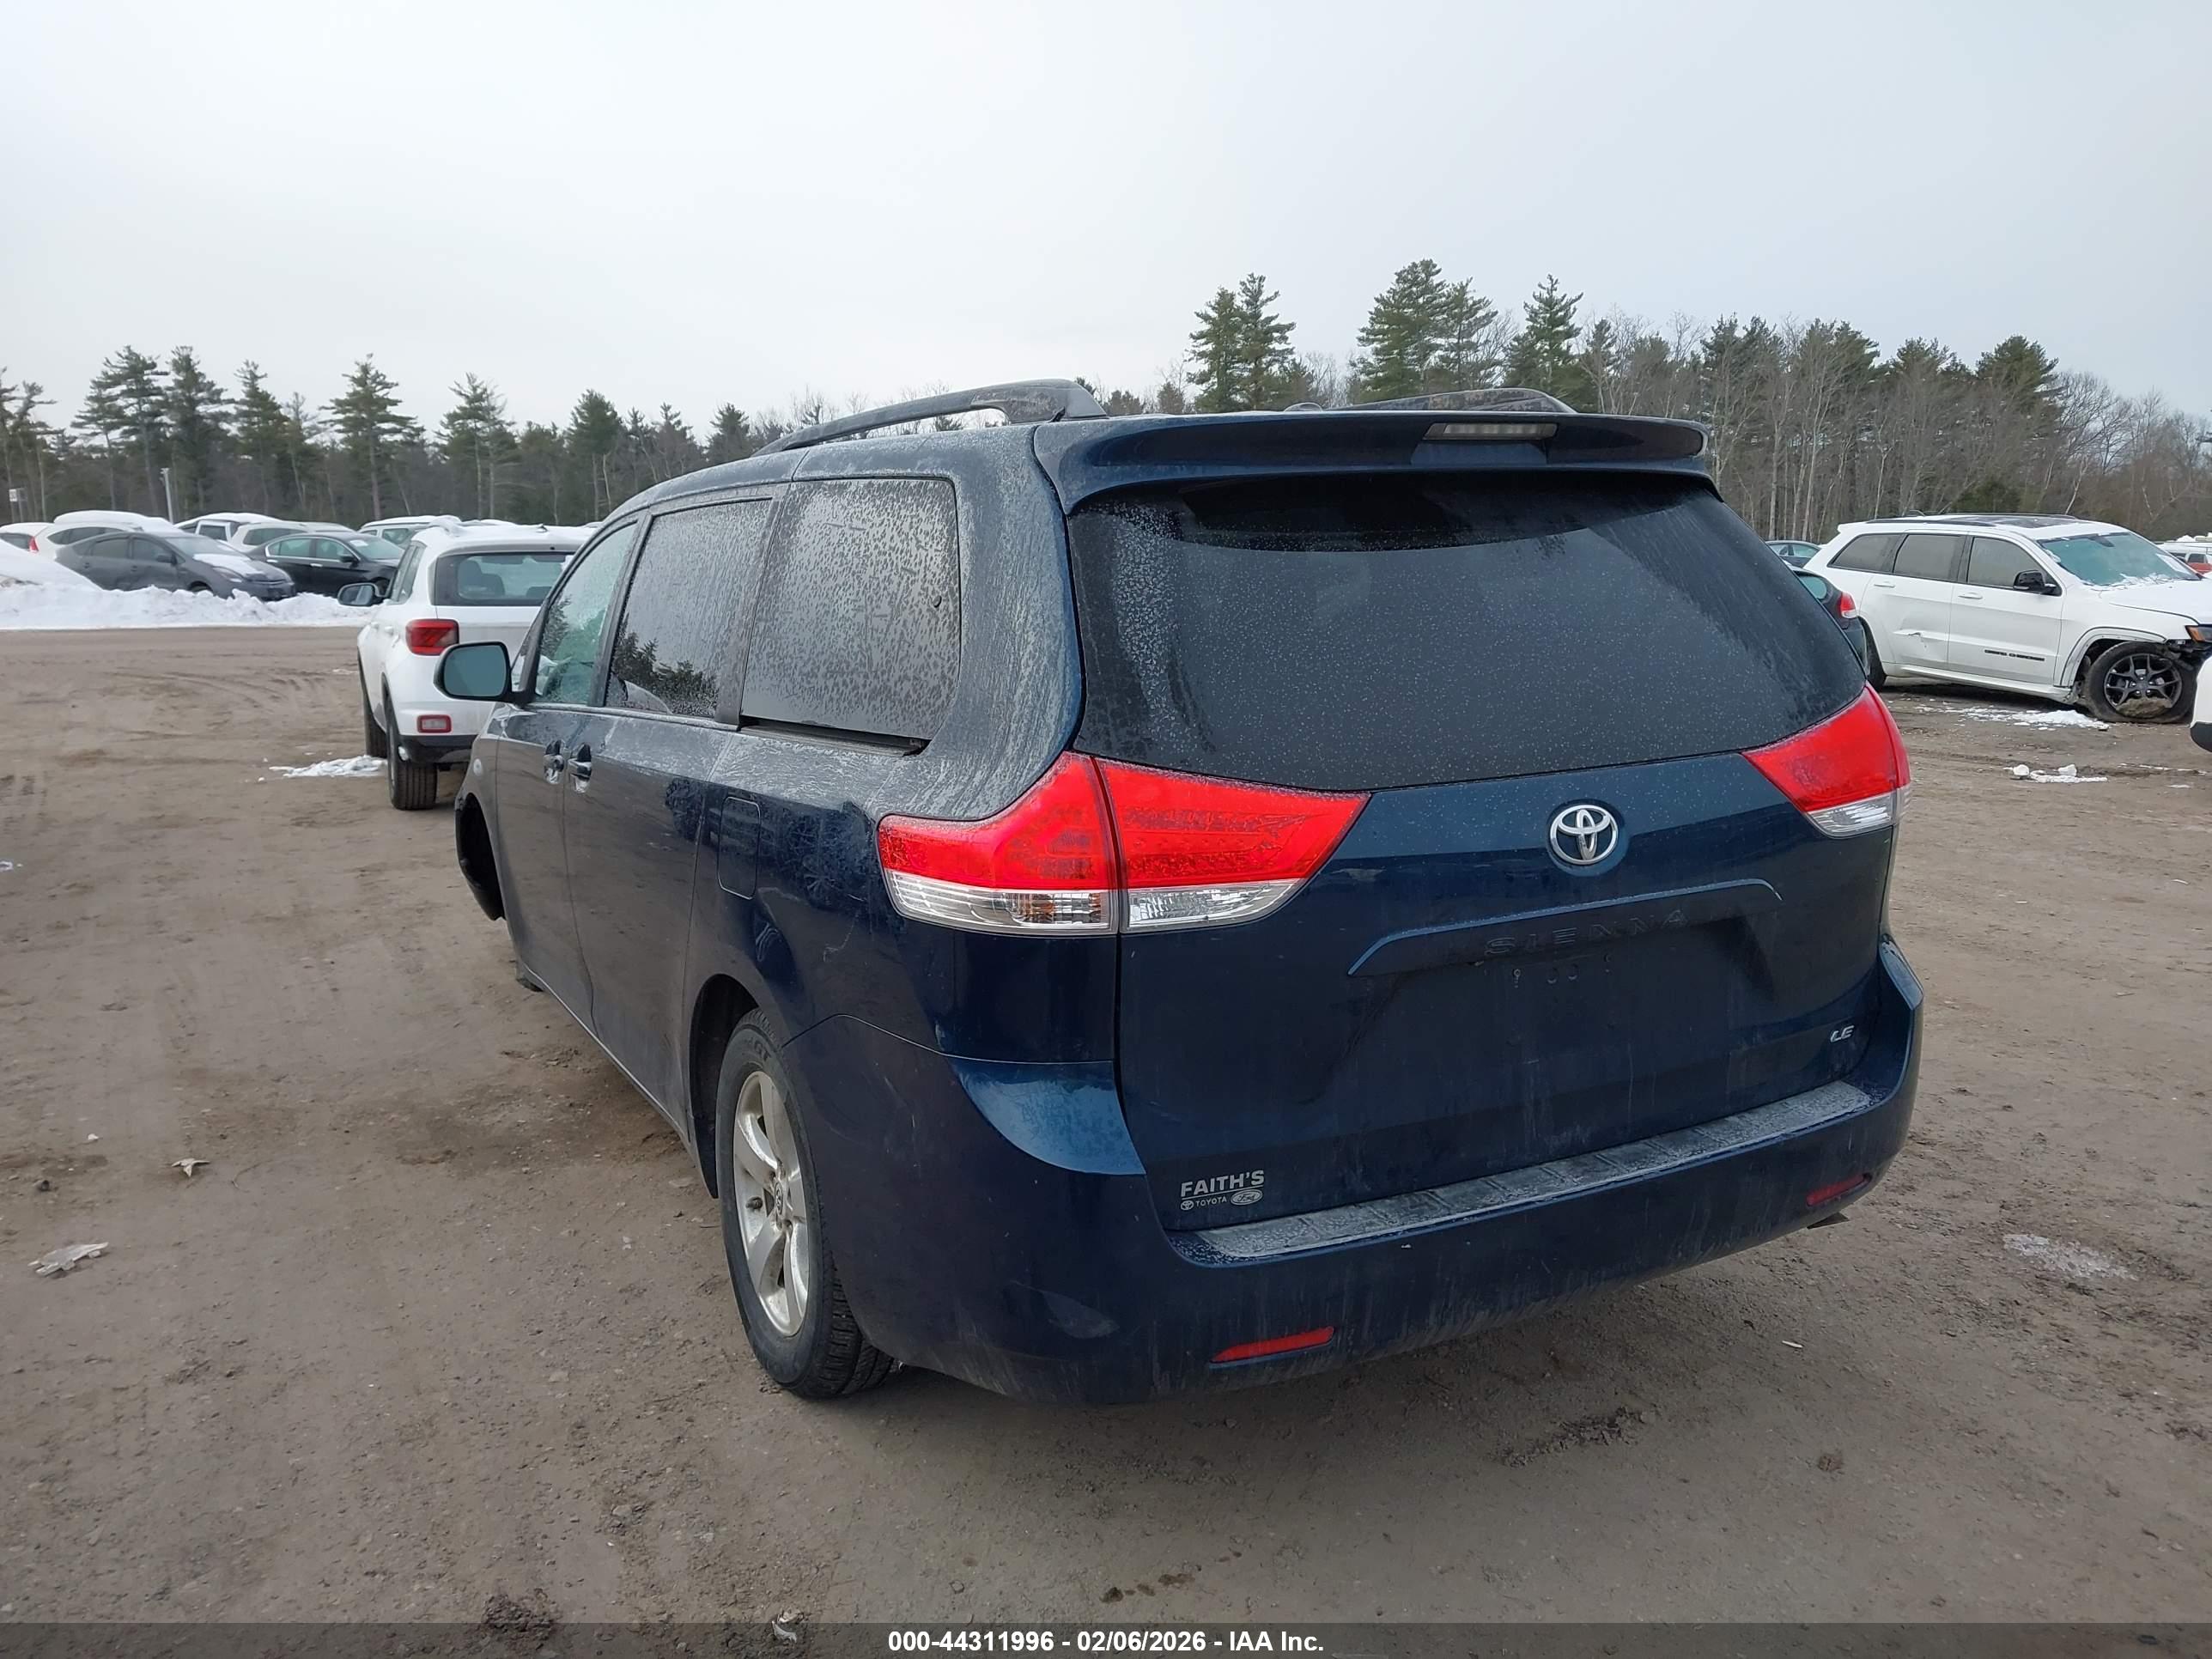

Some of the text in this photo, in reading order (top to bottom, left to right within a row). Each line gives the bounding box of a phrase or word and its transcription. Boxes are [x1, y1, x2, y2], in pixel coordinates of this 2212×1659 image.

[1830, 1024, 1855, 1043] LE
[1181, 1170, 1264, 1198] FAITH'S
[1196, 1195, 1227, 1207] TOYOTA
